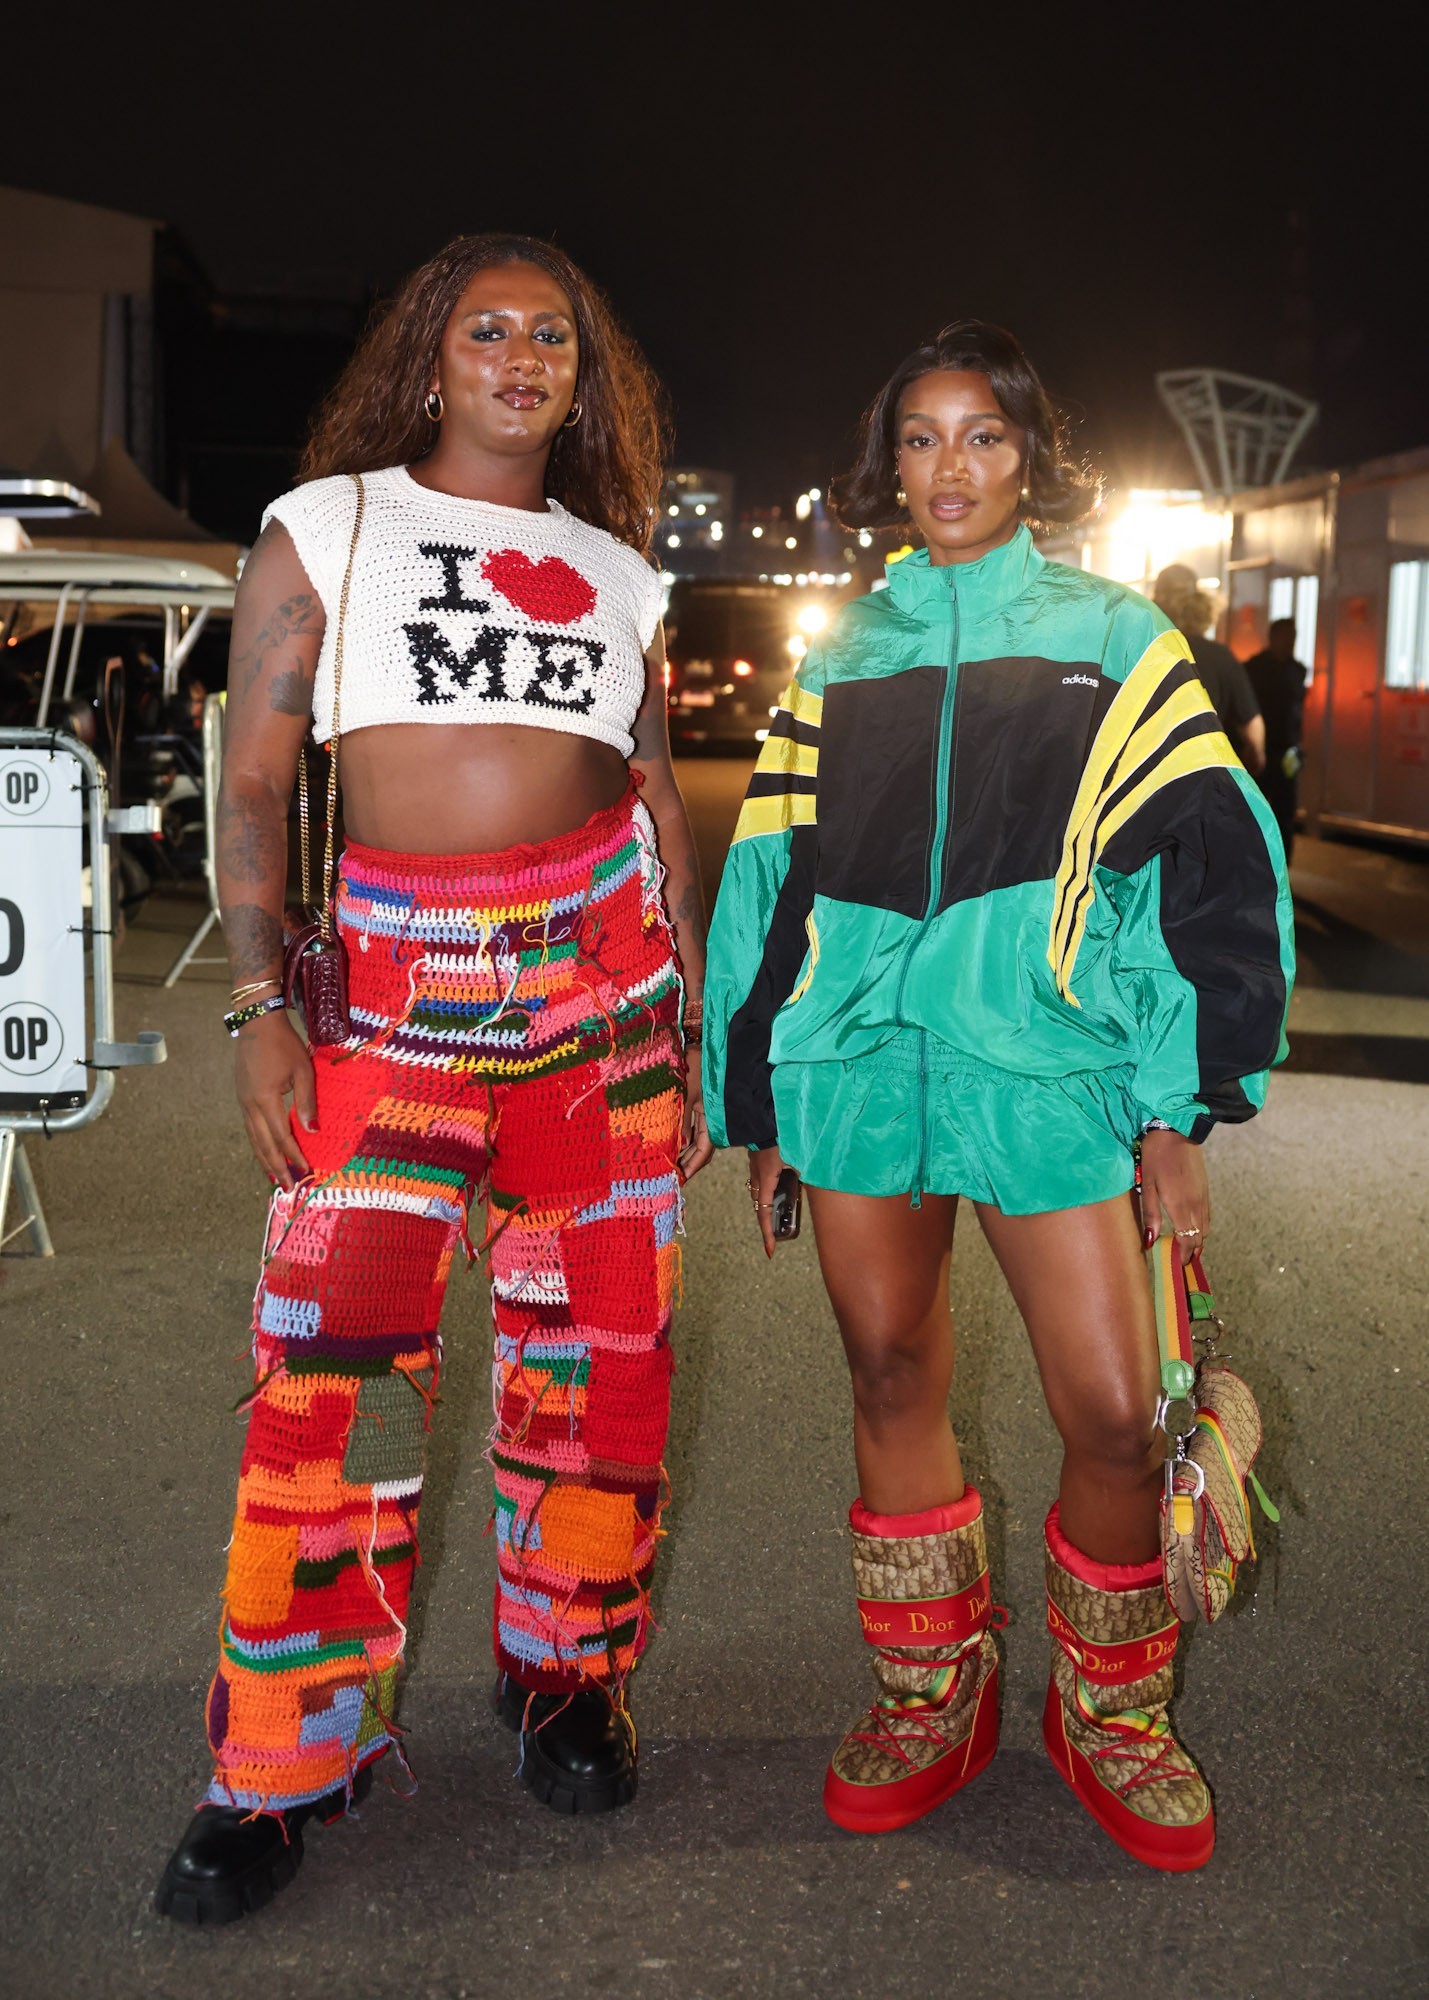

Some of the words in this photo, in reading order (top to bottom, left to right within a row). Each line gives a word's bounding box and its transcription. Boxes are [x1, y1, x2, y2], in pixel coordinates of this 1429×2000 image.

[418, 541, 491, 614] I
[401, 621, 606, 715] ME
[1061, 673, 1100, 688] adidas
[6, 771, 39, 804] OP
[4, 1016, 48, 1061] OP
[907, 1612, 956, 1633] Dior
[1081, 1646, 1126, 1673] Dior
